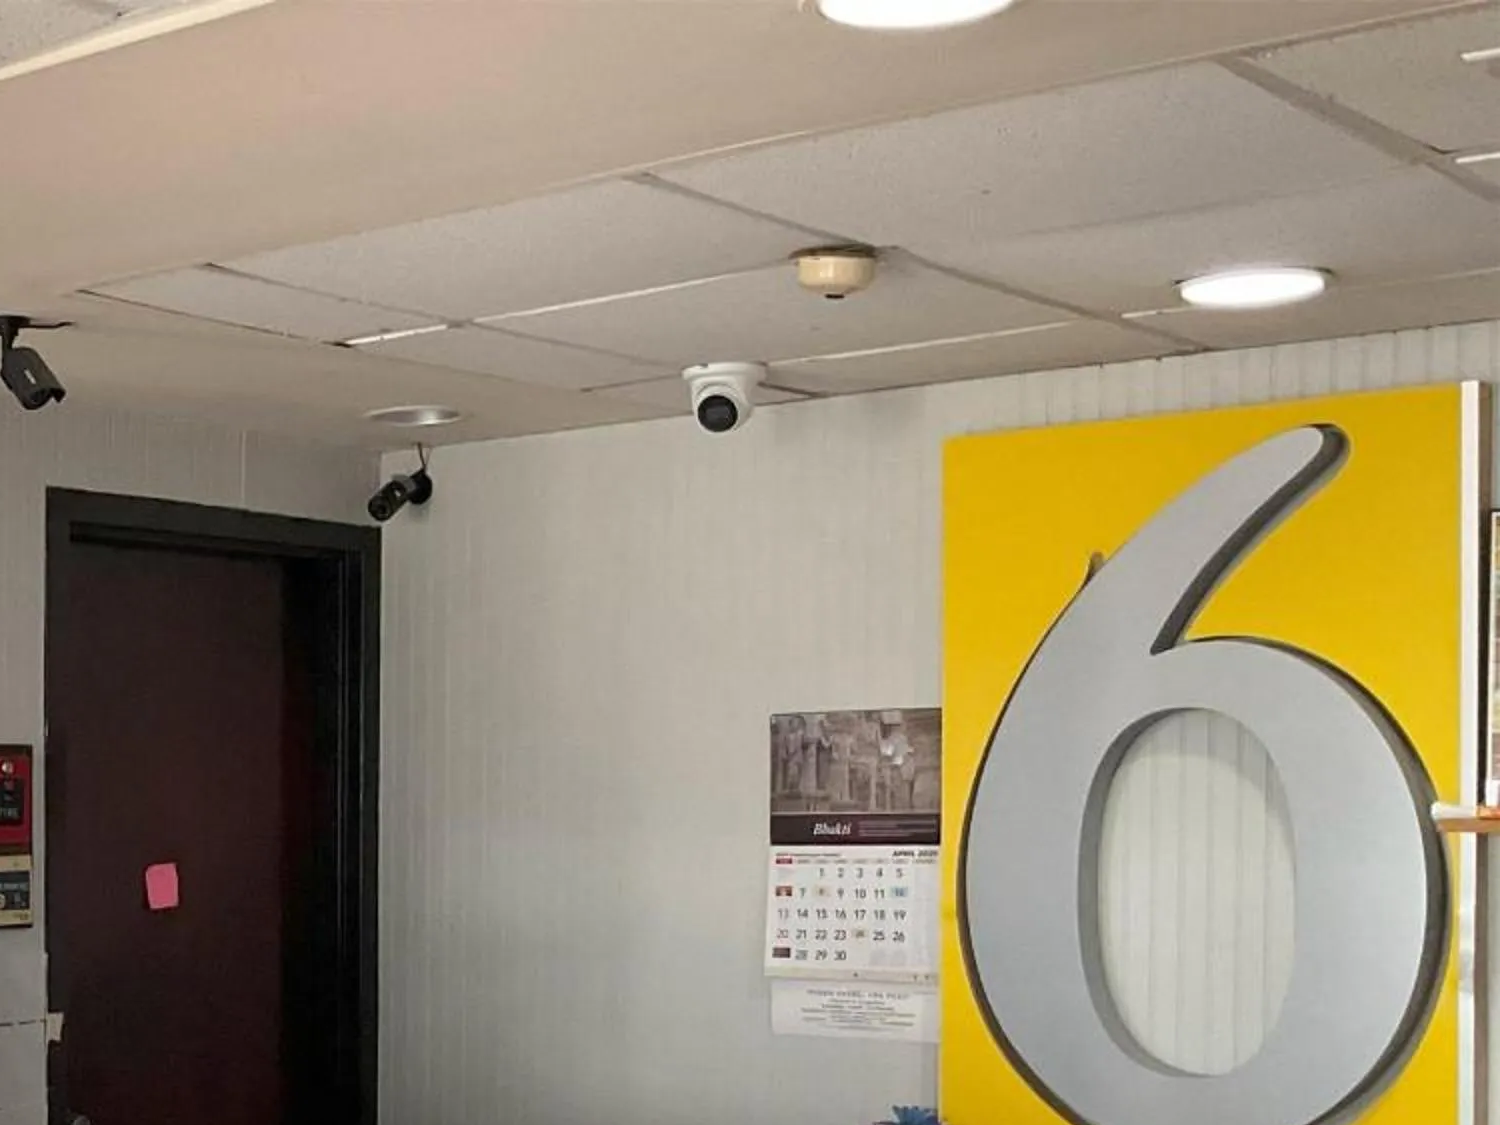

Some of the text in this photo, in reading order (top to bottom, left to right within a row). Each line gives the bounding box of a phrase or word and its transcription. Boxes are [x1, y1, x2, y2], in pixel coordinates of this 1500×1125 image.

[855, 888, 867, 899] 10
[874, 888, 886, 899] 11
[854, 909, 867, 920] 17
